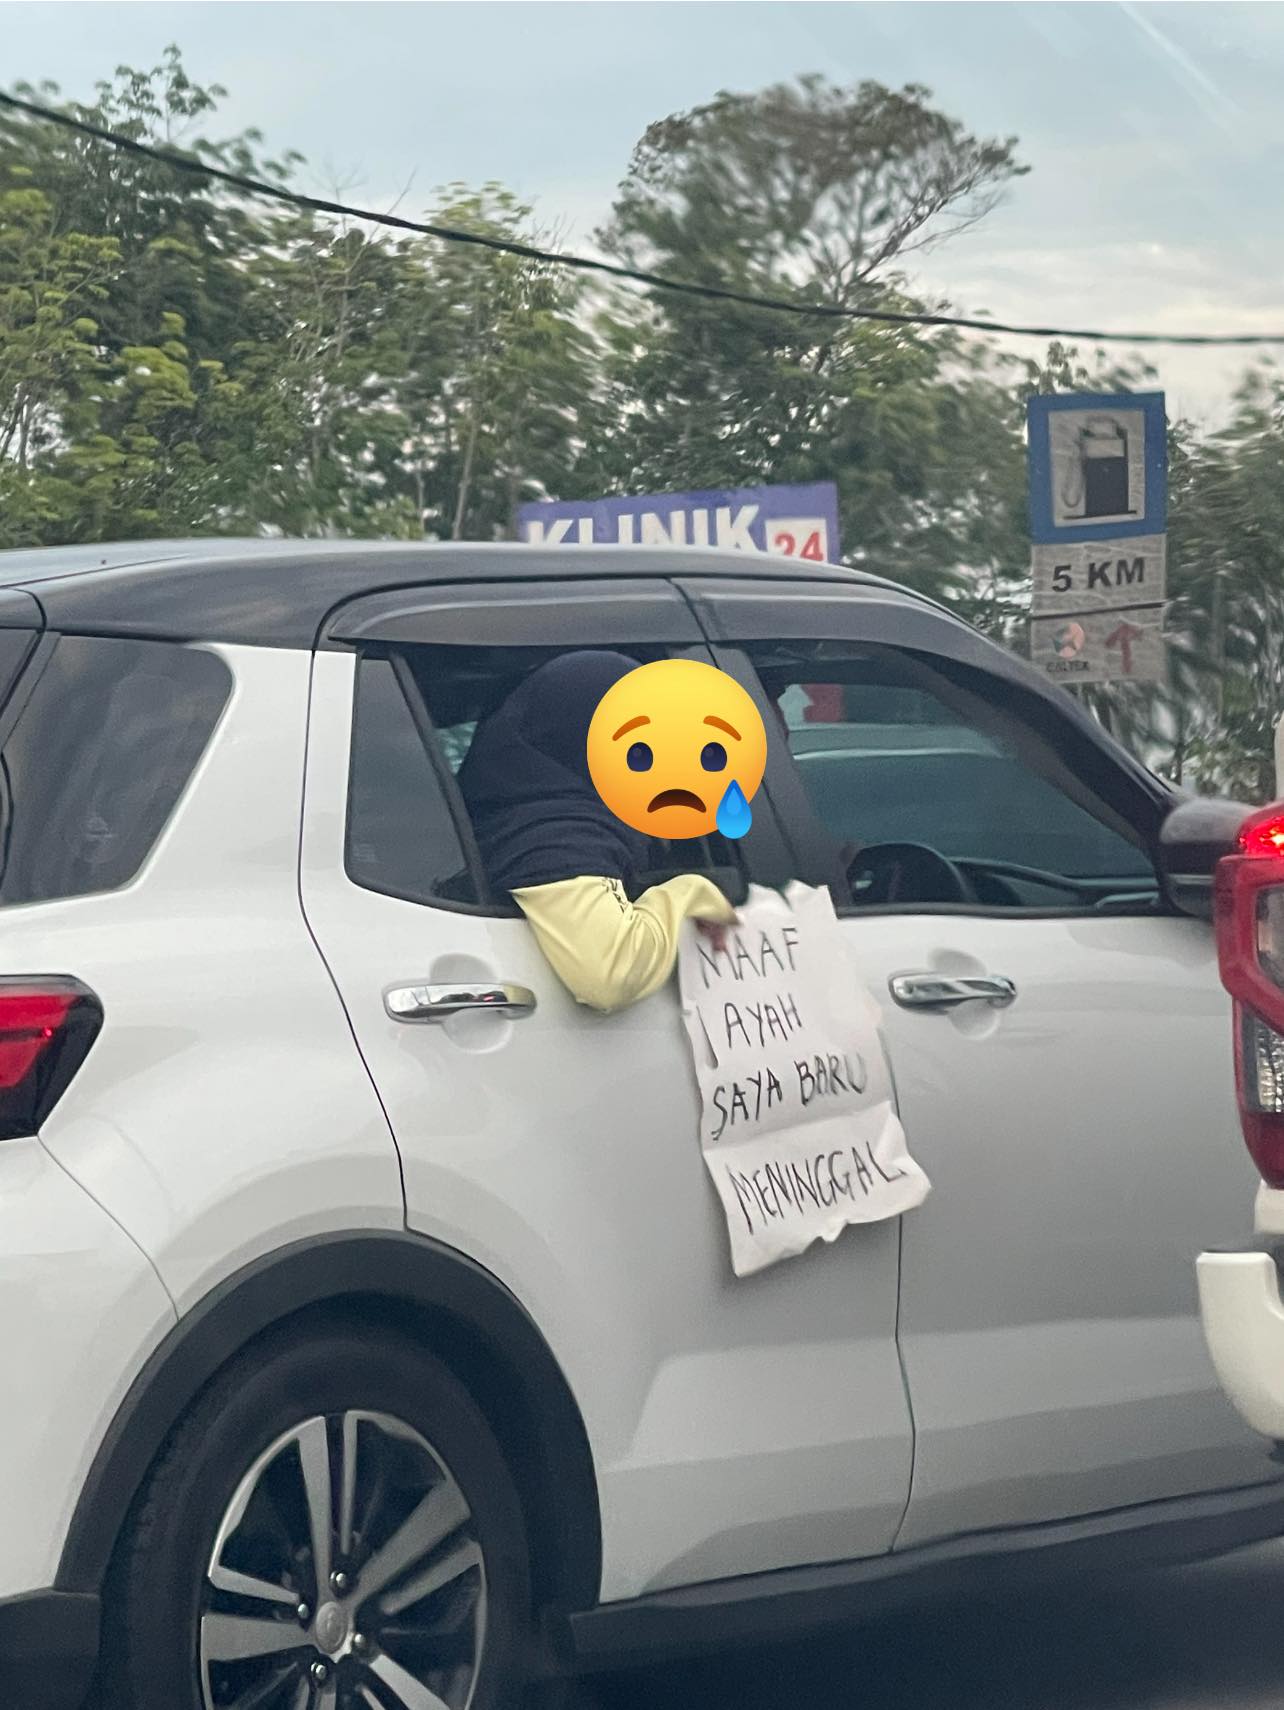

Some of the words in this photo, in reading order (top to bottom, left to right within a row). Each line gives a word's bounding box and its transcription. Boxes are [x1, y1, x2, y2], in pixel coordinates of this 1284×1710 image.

[775, 531, 824, 562] 24
[1051, 565, 1072, 592] 5
[1087, 557, 1145, 589] KM
[696, 927, 799, 989] MAAF
[724, 993, 802, 1048] AYAH
[711, 1067, 782, 1140] SAYA
[795, 1053, 867, 1105] BARU
